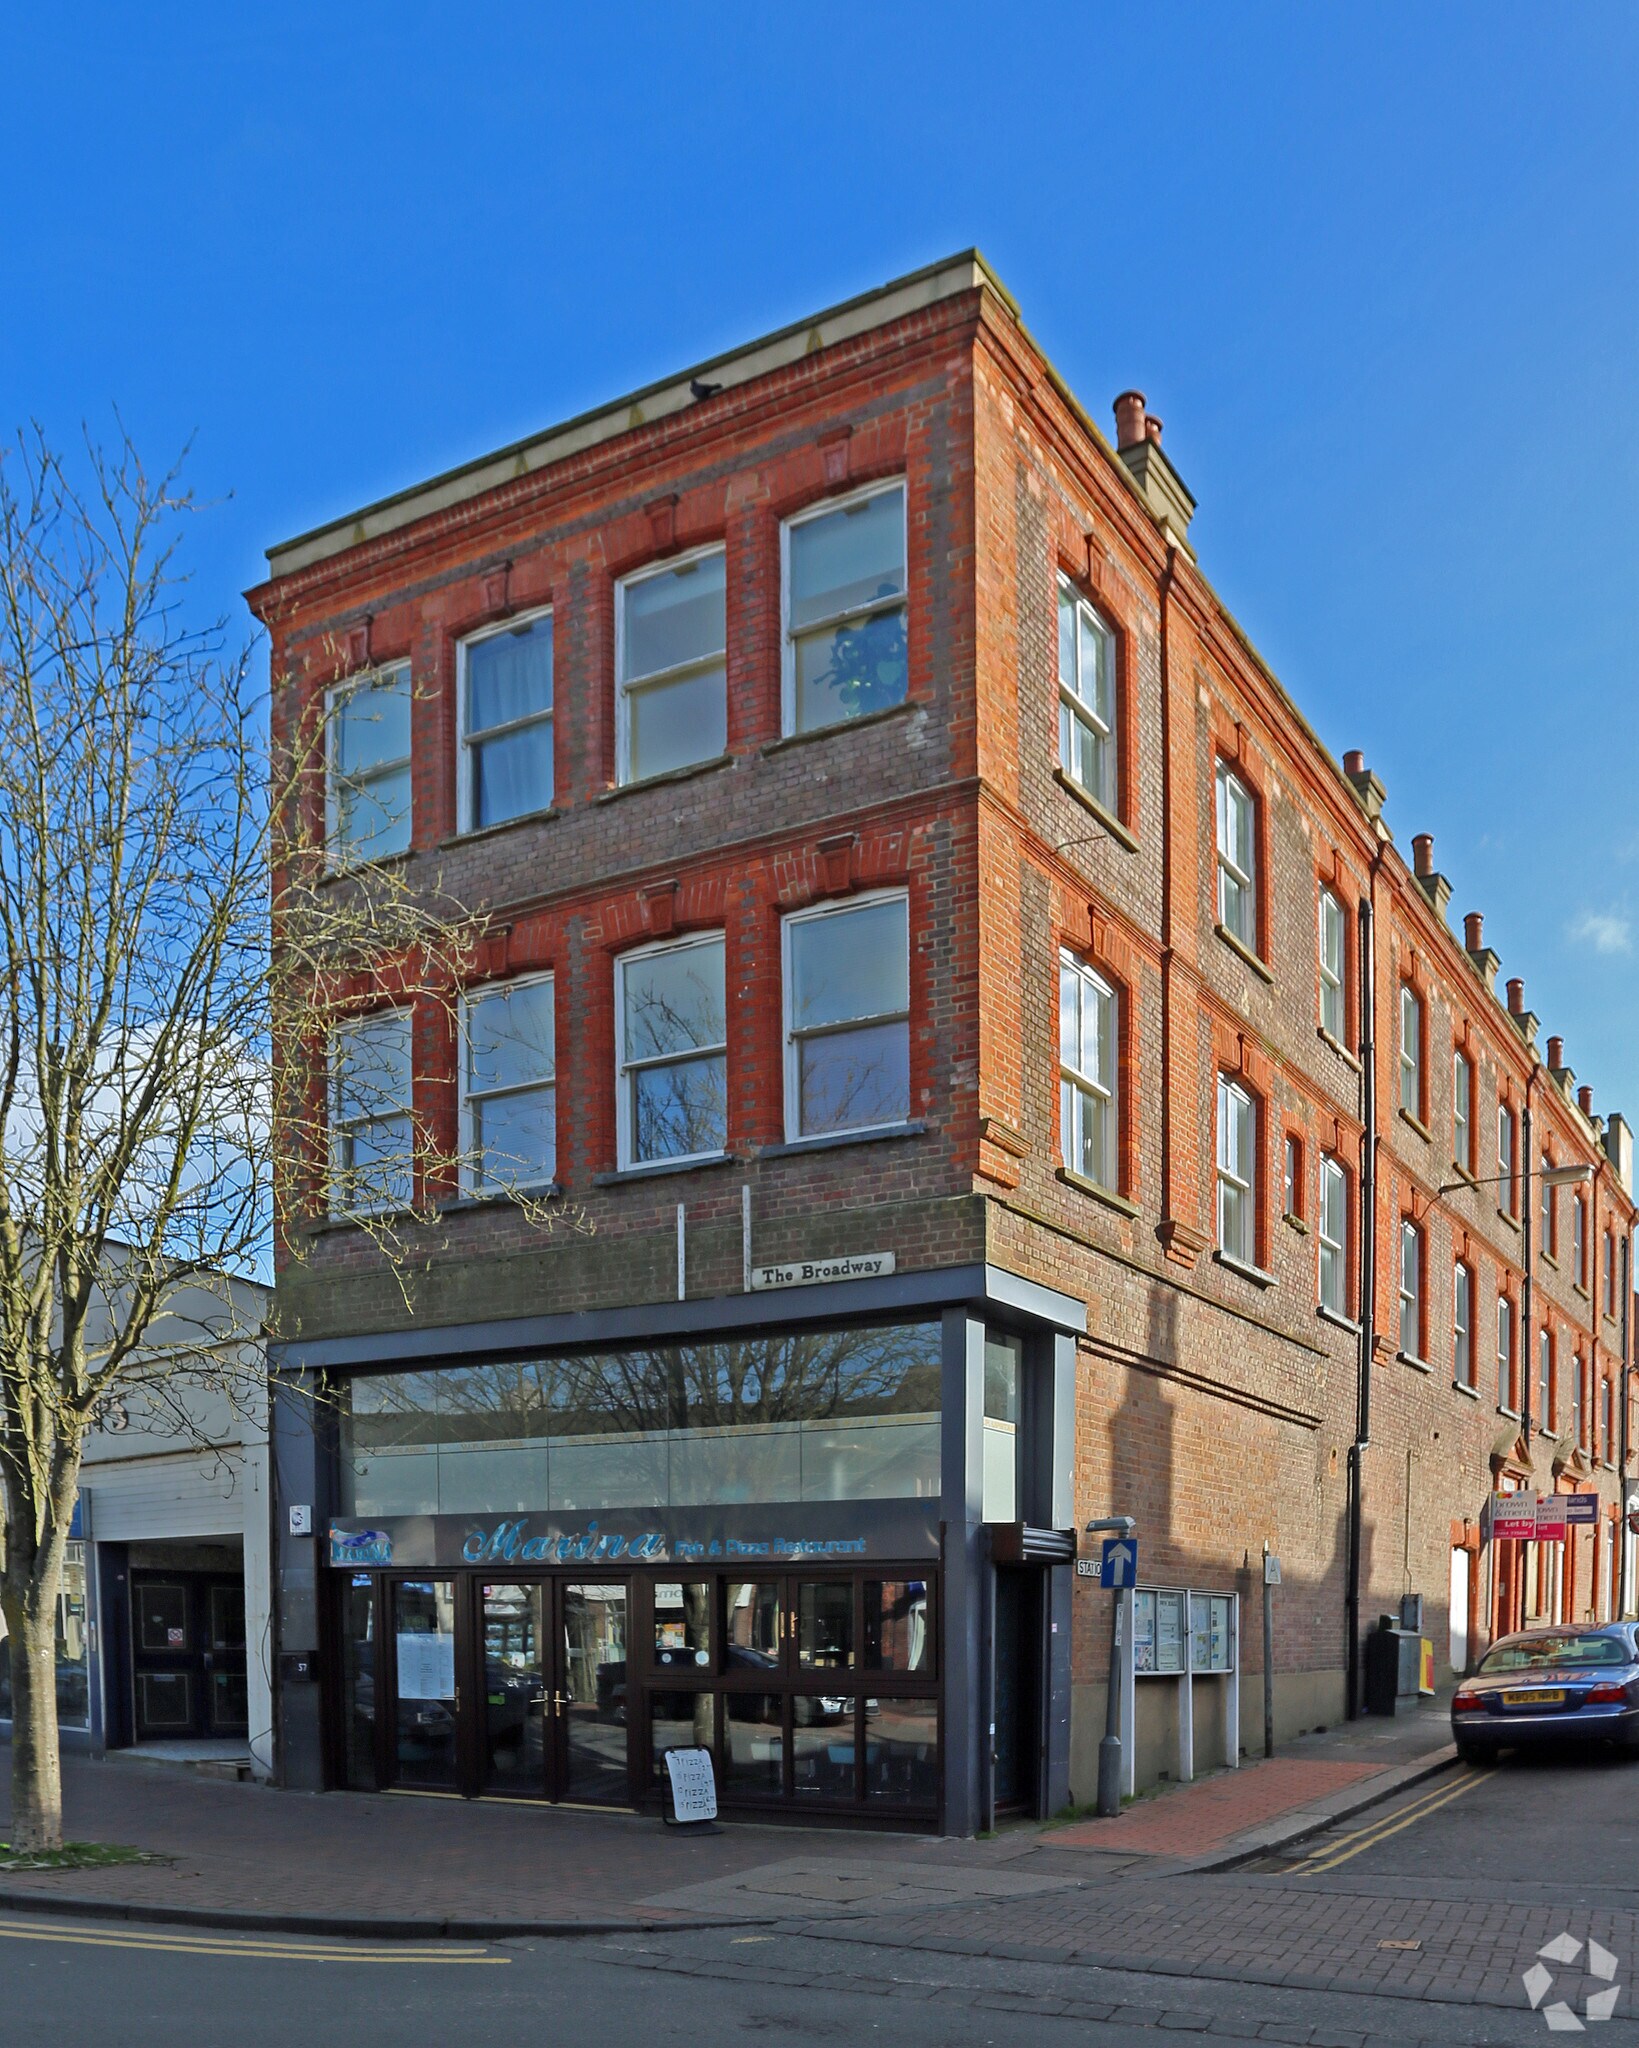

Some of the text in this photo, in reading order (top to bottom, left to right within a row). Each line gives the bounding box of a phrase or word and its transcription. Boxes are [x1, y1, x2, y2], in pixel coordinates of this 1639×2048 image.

[762, 1259, 883, 1284] The Broadway
[1505, 1519, 1535, 1529] Let by
[463, 1519, 867, 1563] Marina Fish & Pizza Restaurant
[1079, 1561, 1102, 1575] STATIO
[298, 1663, 307, 1672] 57
